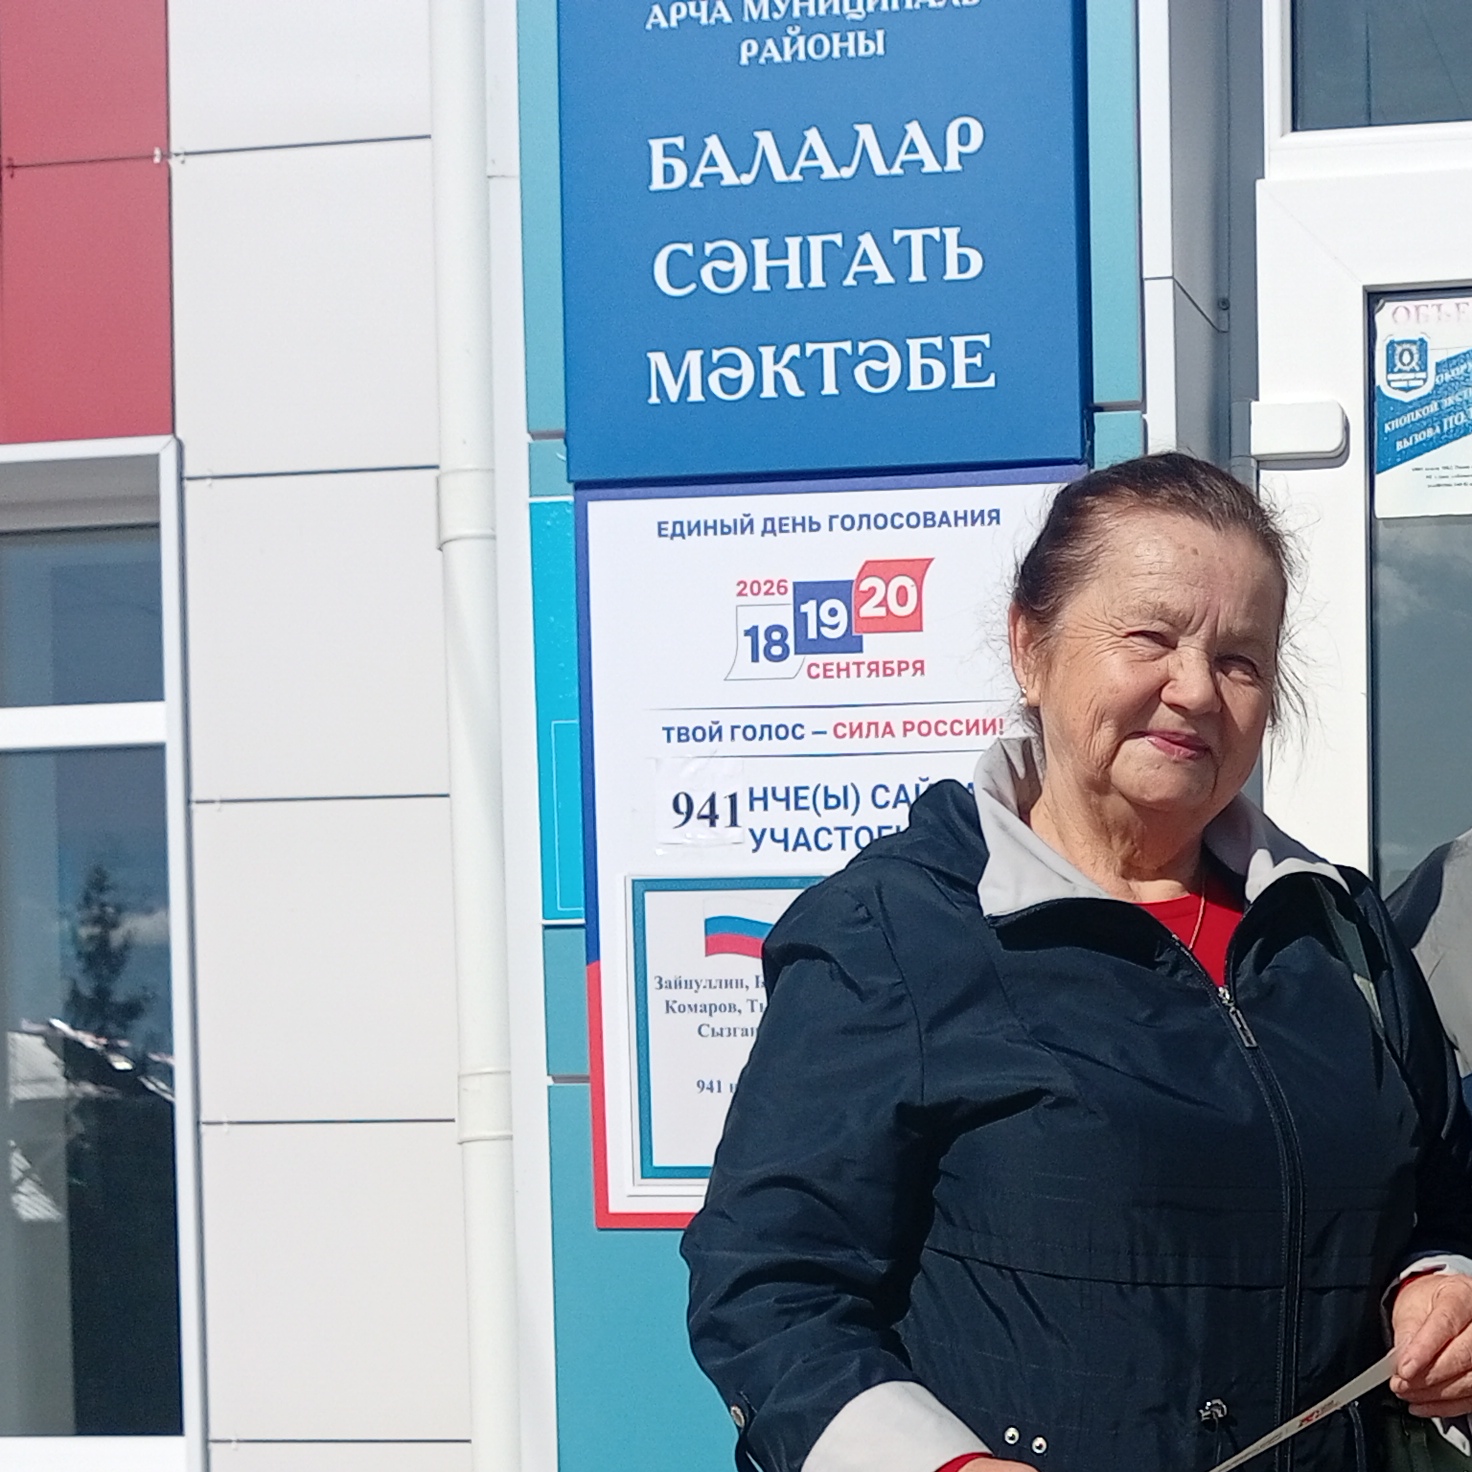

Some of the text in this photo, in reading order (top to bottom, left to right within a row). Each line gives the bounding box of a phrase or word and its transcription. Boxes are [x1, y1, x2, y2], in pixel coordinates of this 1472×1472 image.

[644, 0, 733, 30] АРЧА
[739, 25, 886, 66] РАЙОНЫ
[647, 116, 985, 192] БАЛАЛАР
[652, 227, 984, 297] СӘНГАТЬ
[646, 333, 996, 405] МӘКТӘБЕ
[1384, 400, 1439, 433] КНОПКОЙ
[1396, 425, 1440, 451] ВЫЗОВА
[657, 508, 1001, 540] ЕДИНЫЙ ДЕНЬ ГОЛОСОВАНИЯ
[736, 579, 788, 597] 2026
[857, 574, 919, 618] 20
[799, 598, 848, 640] 19
[743, 624, 790, 663] 18
[806, 660, 925, 680] СЕНТЯБРЯ
[662, 720, 722, 744] ТВОЙ
[731, 723, 805, 742] ГОЛОС
[832, 721, 895, 740] СИЛА
[902, 717, 1005, 738] РОССИИ!
[671, 790, 743, 829] 941
[749, 782, 860, 817] НЧЕ(Ы)
[665, 999, 742, 1017] Комаров,
[696, 1079, 722, 1094] 941
